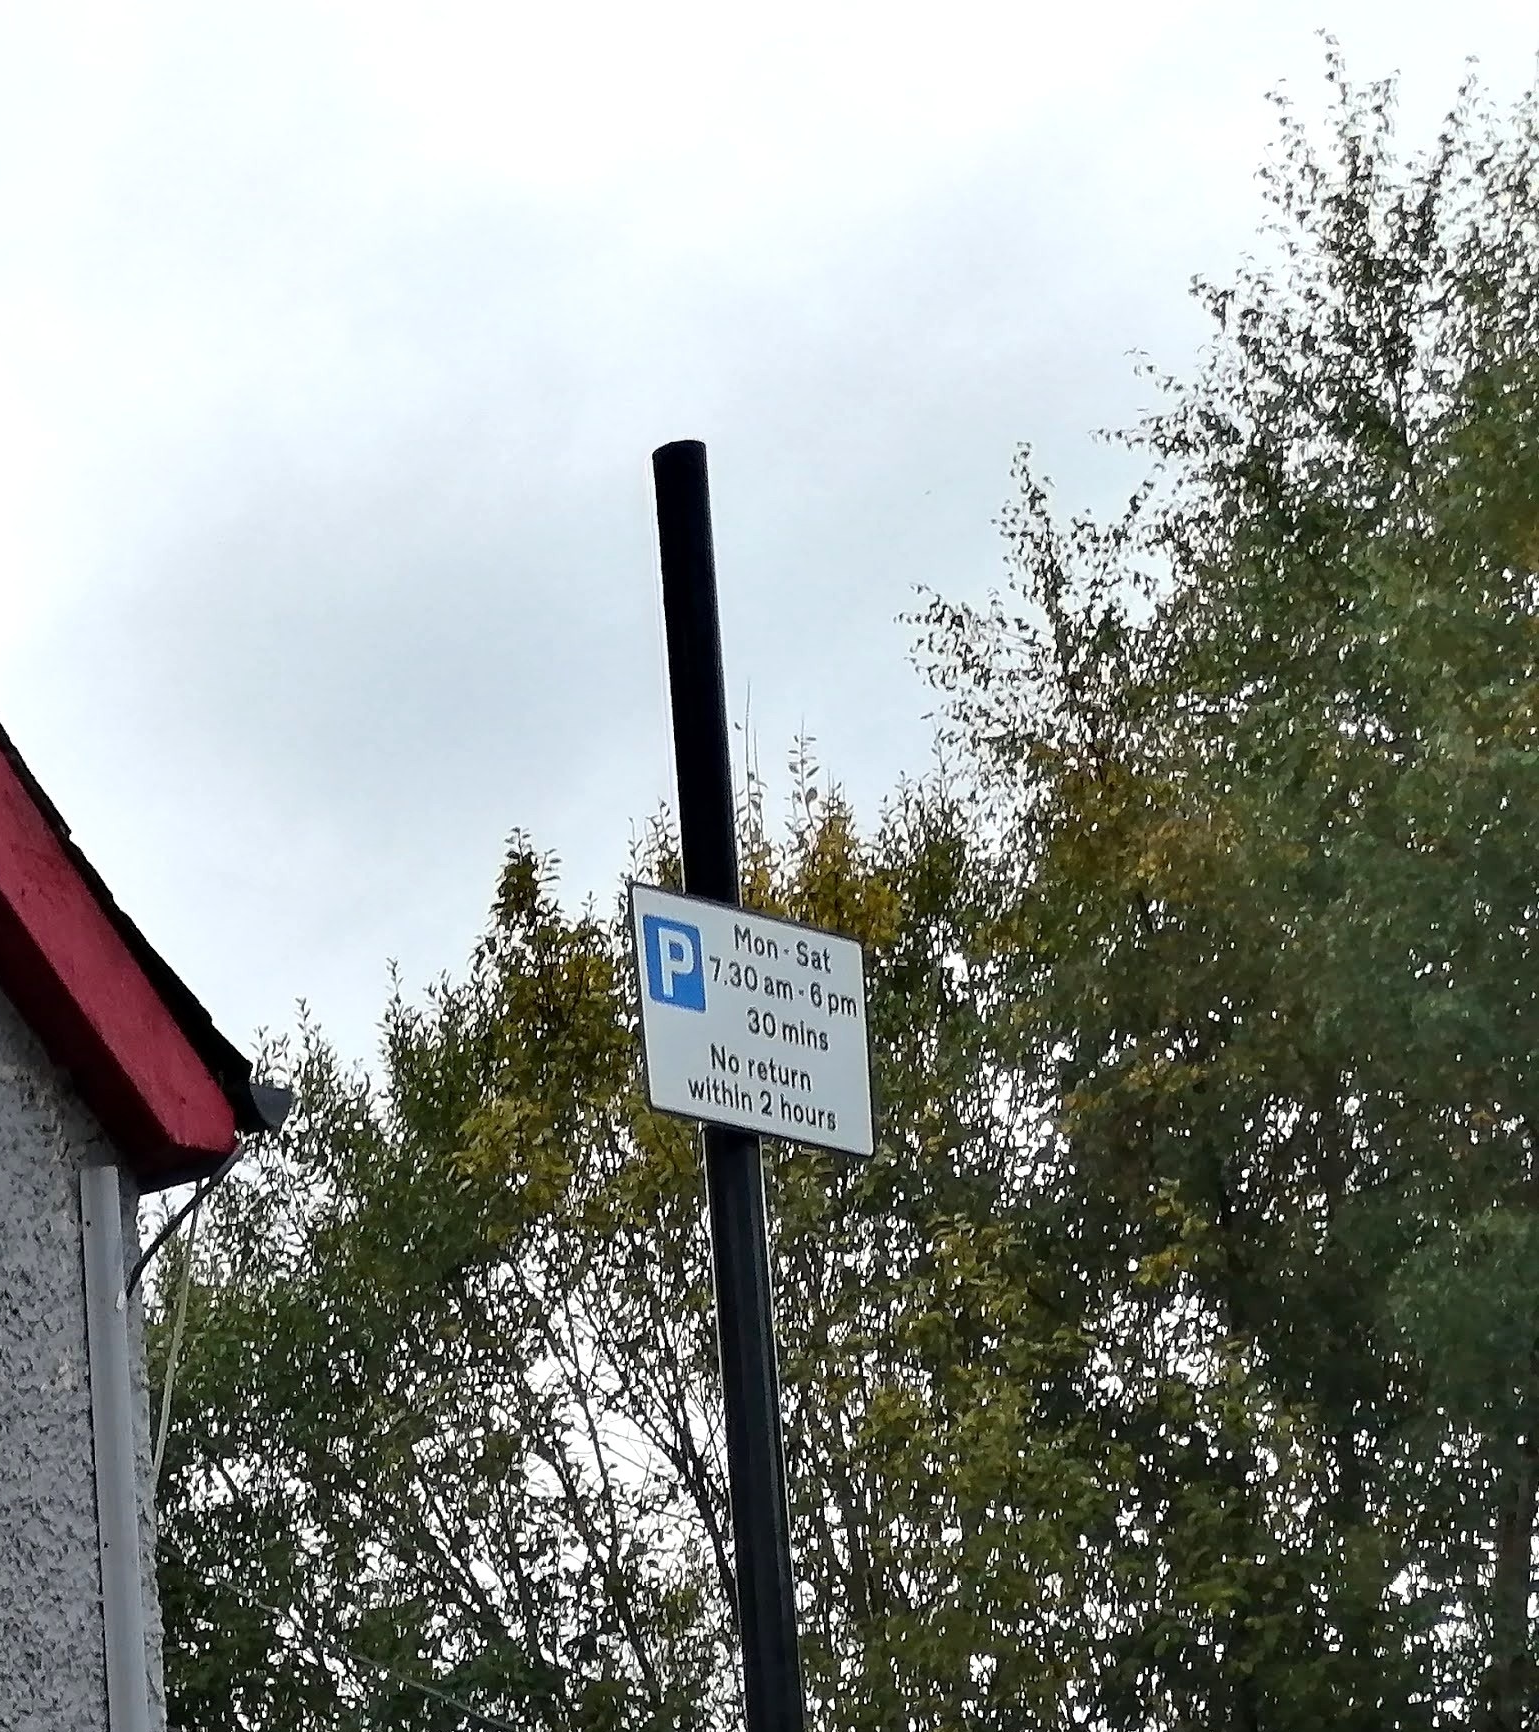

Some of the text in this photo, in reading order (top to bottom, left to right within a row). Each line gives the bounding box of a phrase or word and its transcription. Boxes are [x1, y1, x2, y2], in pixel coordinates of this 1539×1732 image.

[658, 926, 694, 997] P
[734, 923, 778, 960] Mon
[796, 940, 831, 974] Sat
[709, 955, 758, 992] 7.30
[764, 977, 794, 1000] am
[810, 982, 823, 1008] 6
[827, 992, 858, 1018] pm
[746, 1006, 829, 1051] 30 mins
[710, 1043, 811, 1092] No return
[688, 1078, 837, 1132] within 2 hours
